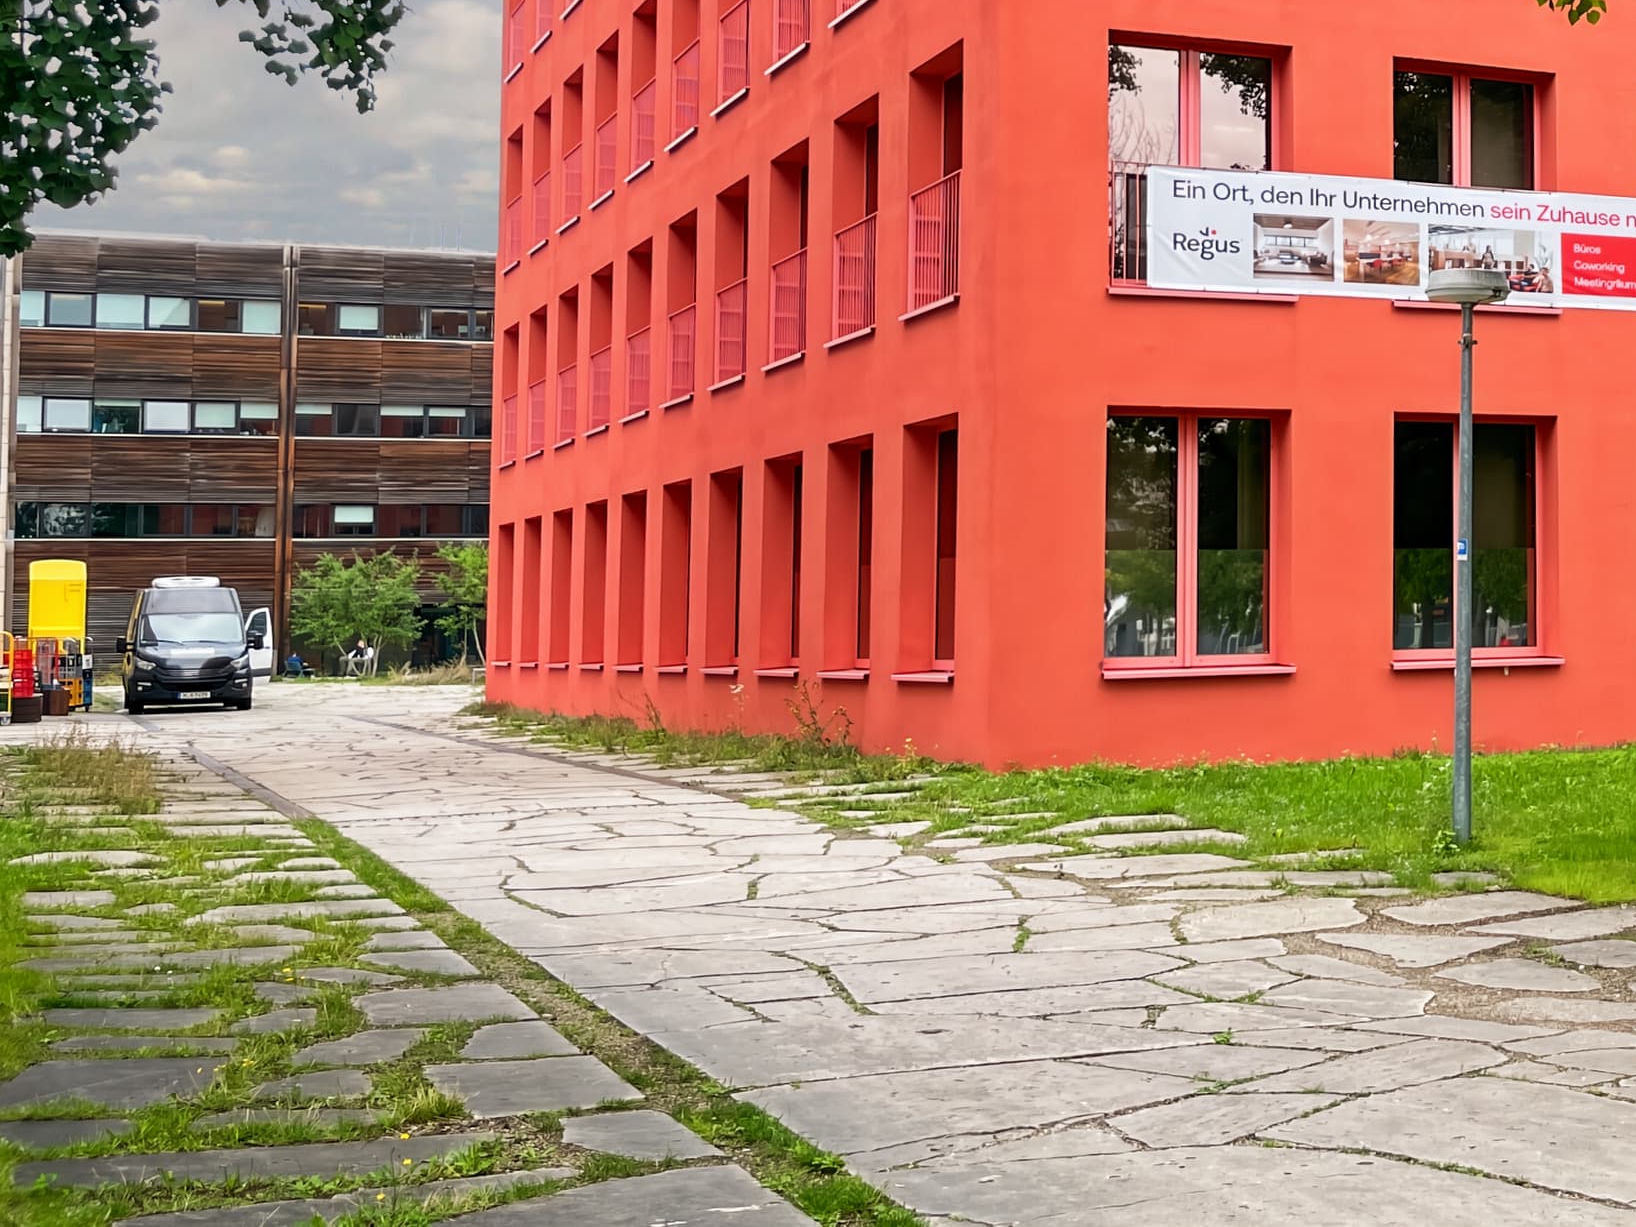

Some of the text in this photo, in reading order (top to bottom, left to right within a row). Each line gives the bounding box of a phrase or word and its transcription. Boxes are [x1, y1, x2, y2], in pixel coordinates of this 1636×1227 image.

[1172, 179, 1206, 200] Ein
[1213, 182, 1254, 206] Ort,
[1260, 185, 1304, 206] den
[1309, 188, 1337, 208] Ihr
[1343, 190, 1485, 218] Unternehmen
[1490, 202, 1532, 221] sein
[1536, 204, 1621, 227] Zuhause
[1172, 232, 1241, 261] Regus
[1573, 259, 1626, 275] Coworking
